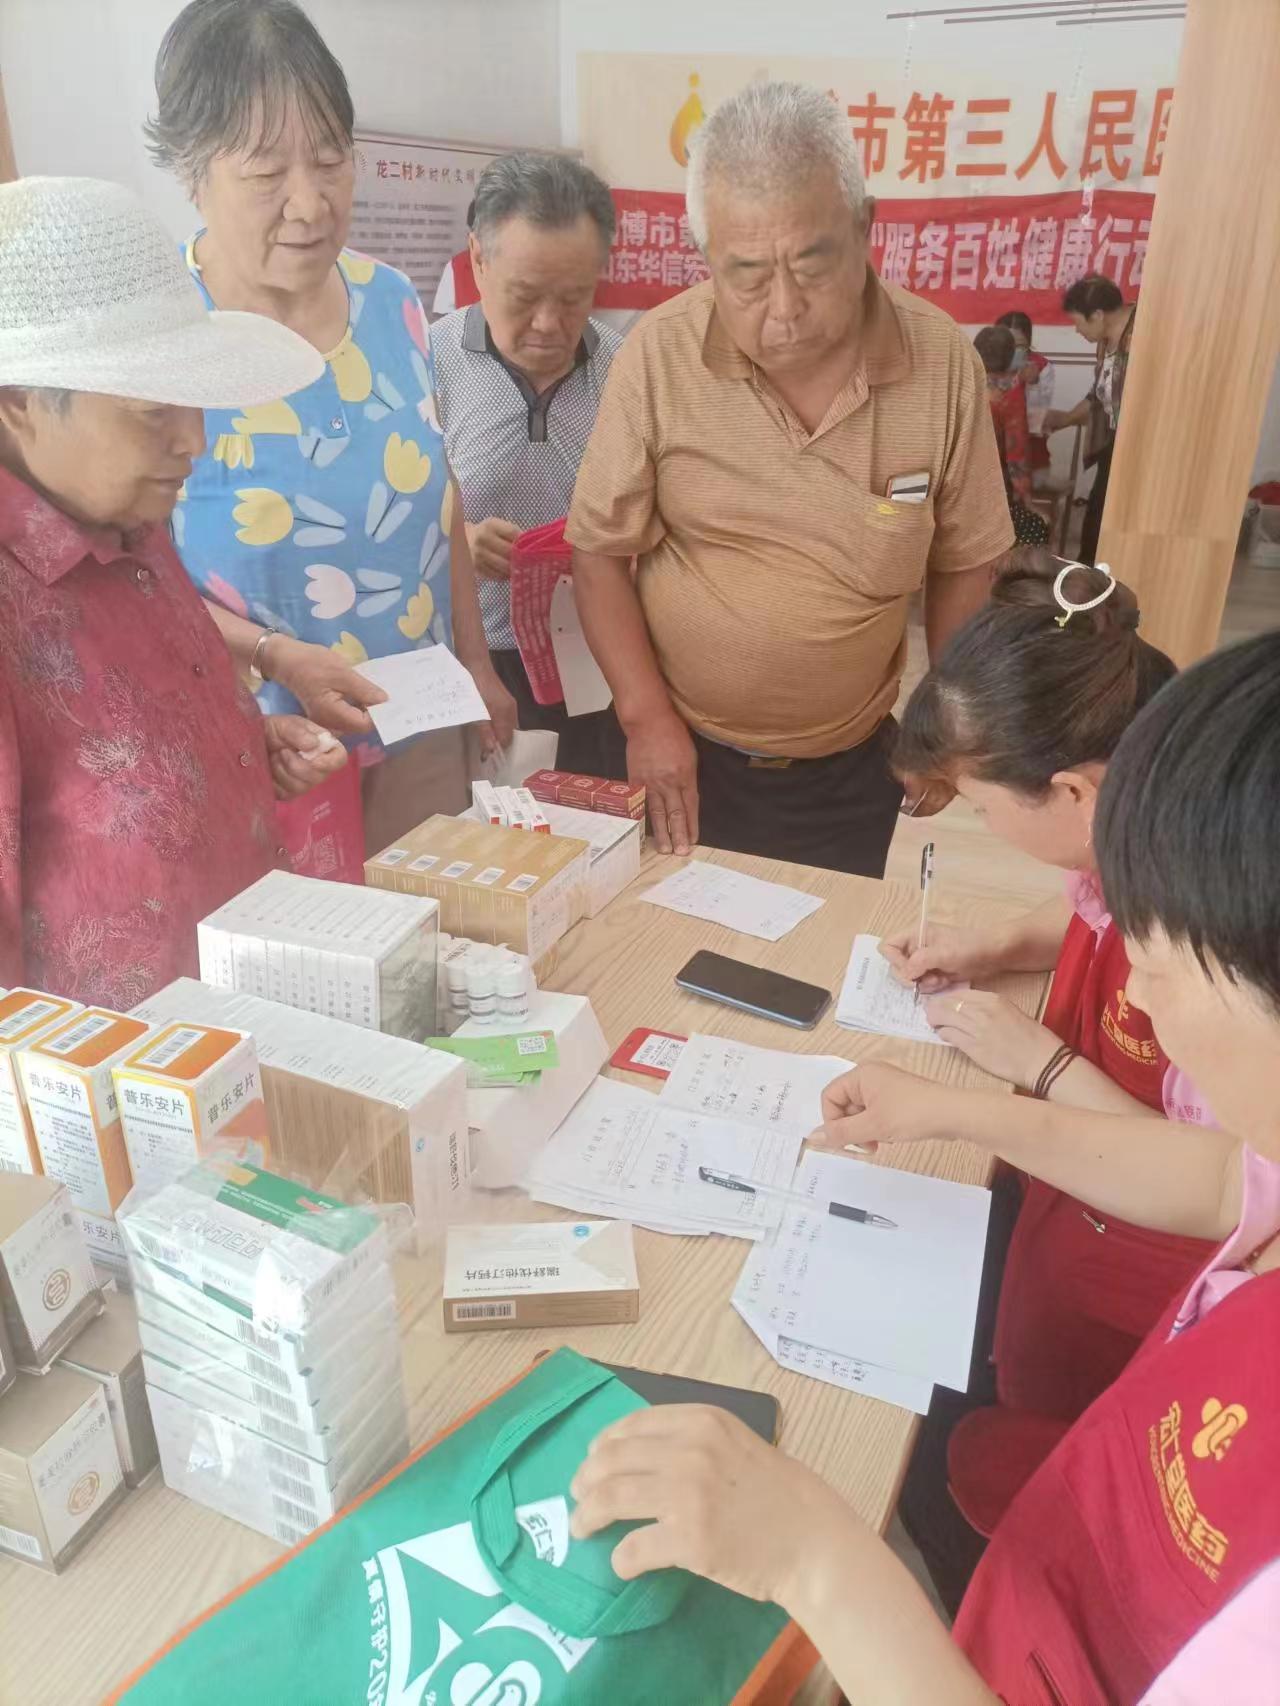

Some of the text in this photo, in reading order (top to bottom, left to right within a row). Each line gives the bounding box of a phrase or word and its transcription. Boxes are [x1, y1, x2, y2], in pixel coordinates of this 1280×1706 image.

[832, 88, 1174, 184] 市第三人民
[123, 1088, 185, 1117] 普乐安片
[206, 1073, 256, 1125] 普乐安片
